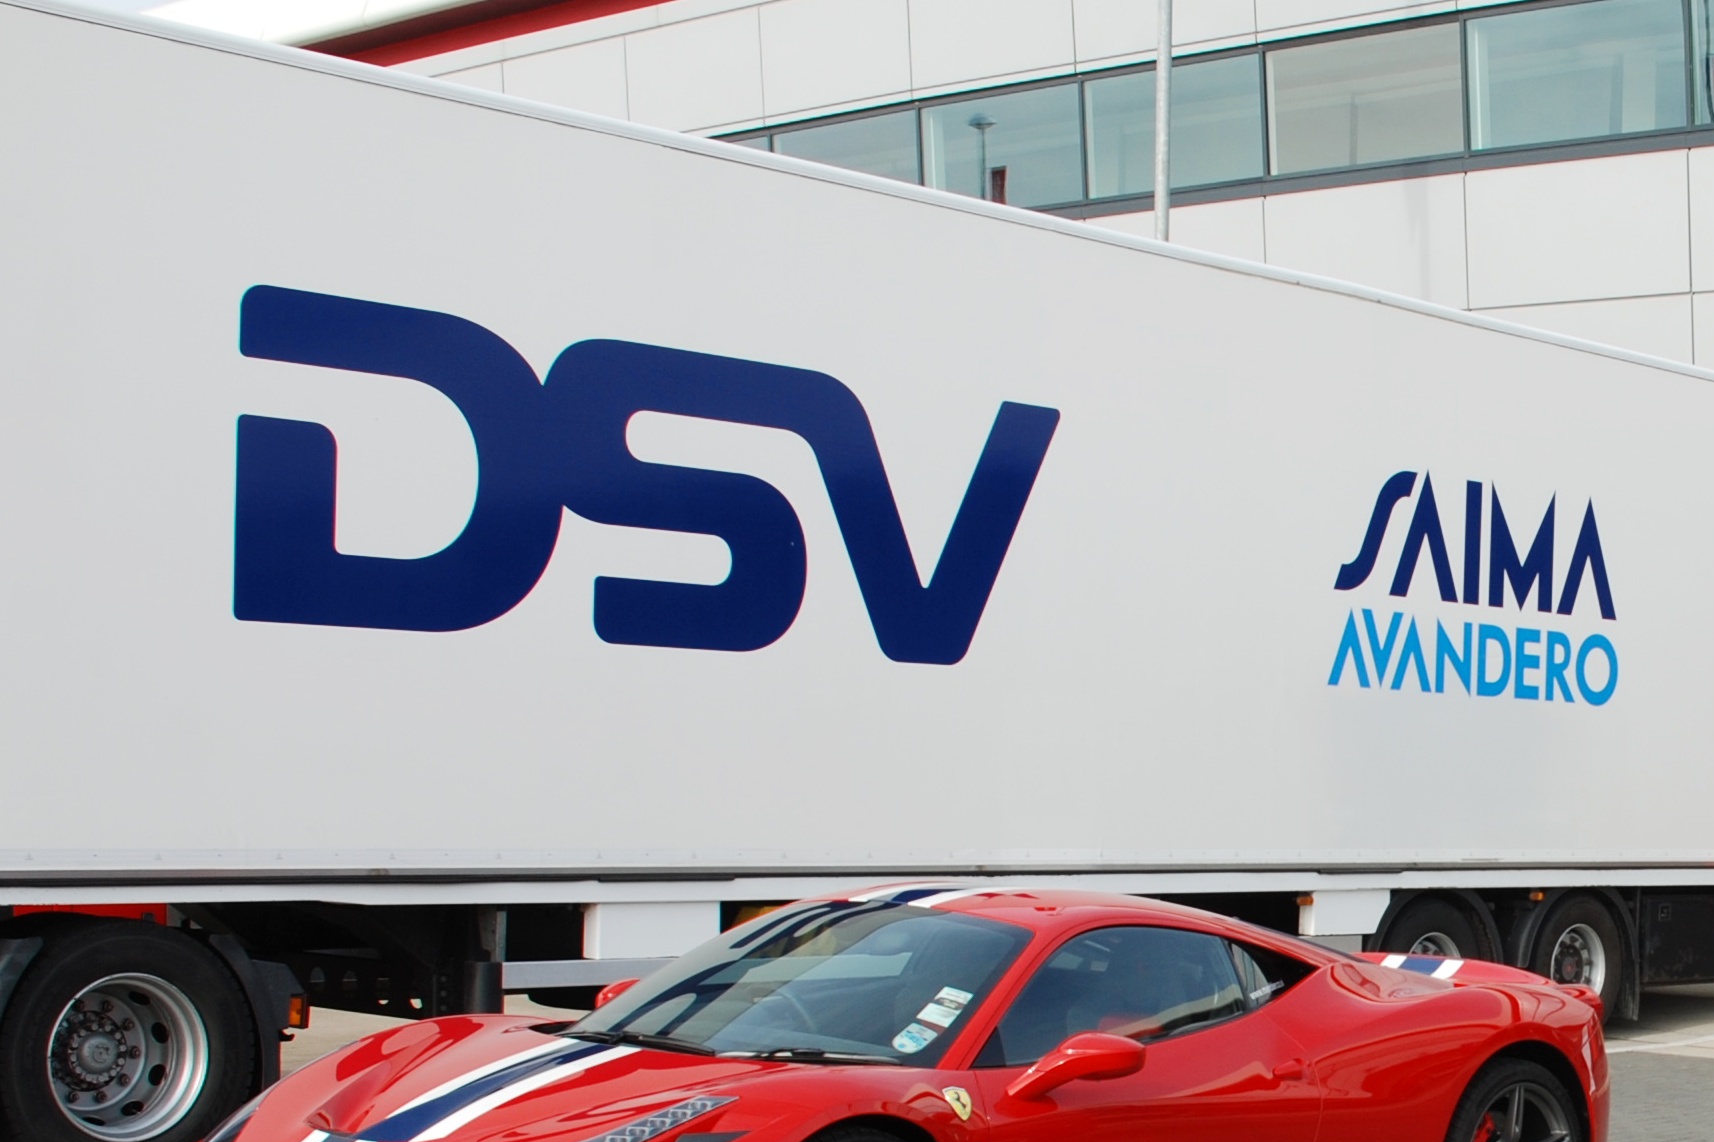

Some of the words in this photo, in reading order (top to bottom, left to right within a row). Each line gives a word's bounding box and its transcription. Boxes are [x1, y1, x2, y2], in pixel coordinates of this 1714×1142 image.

[233, 284, 1061, 665] DSV
[1333, 469, 1617, 621] SAIMA
[1327, 608, 1618, 706] AVANDERO
